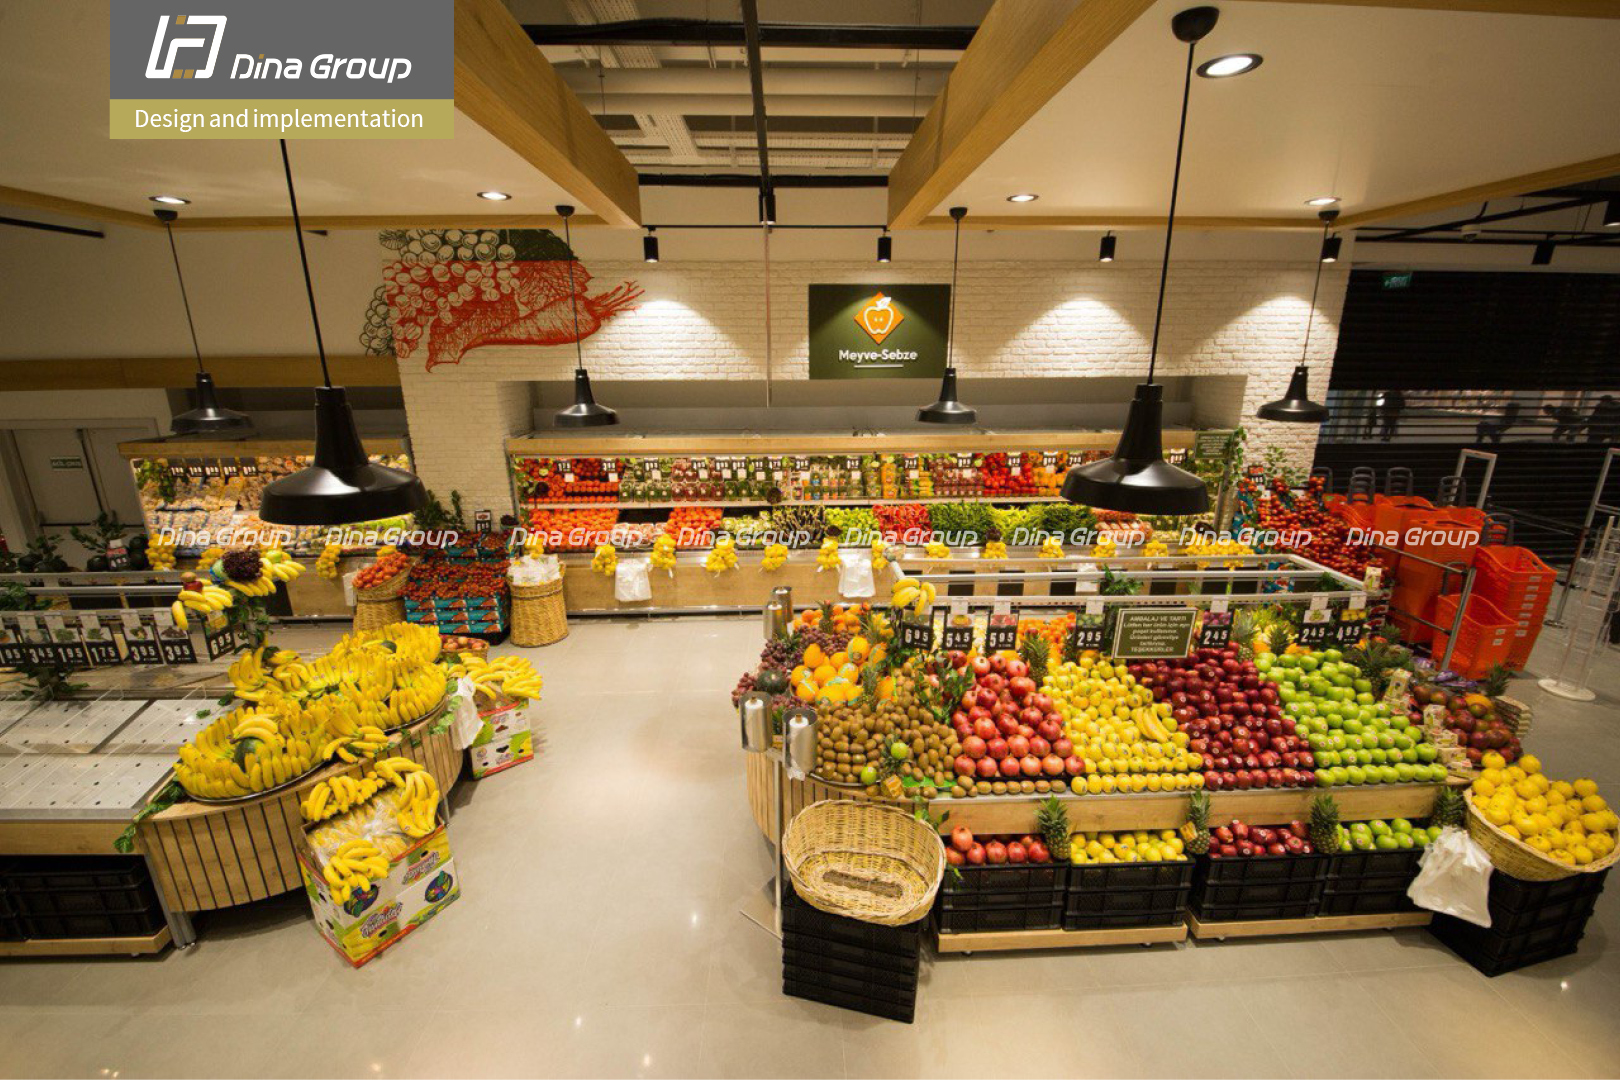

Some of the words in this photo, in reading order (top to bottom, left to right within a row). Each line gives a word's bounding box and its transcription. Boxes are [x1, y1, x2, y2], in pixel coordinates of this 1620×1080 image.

[838, 349, 918, 364] Meyve-Sebze
[946, 632, 970, 648] 545
[1077, 631, 1102, 647] 295
[1203, 630, 1228, 645] 245
[1302, 627, 1325, 642] 245
[210, 631, 232, 656] 695
[164, 645, 190, 661] 395
